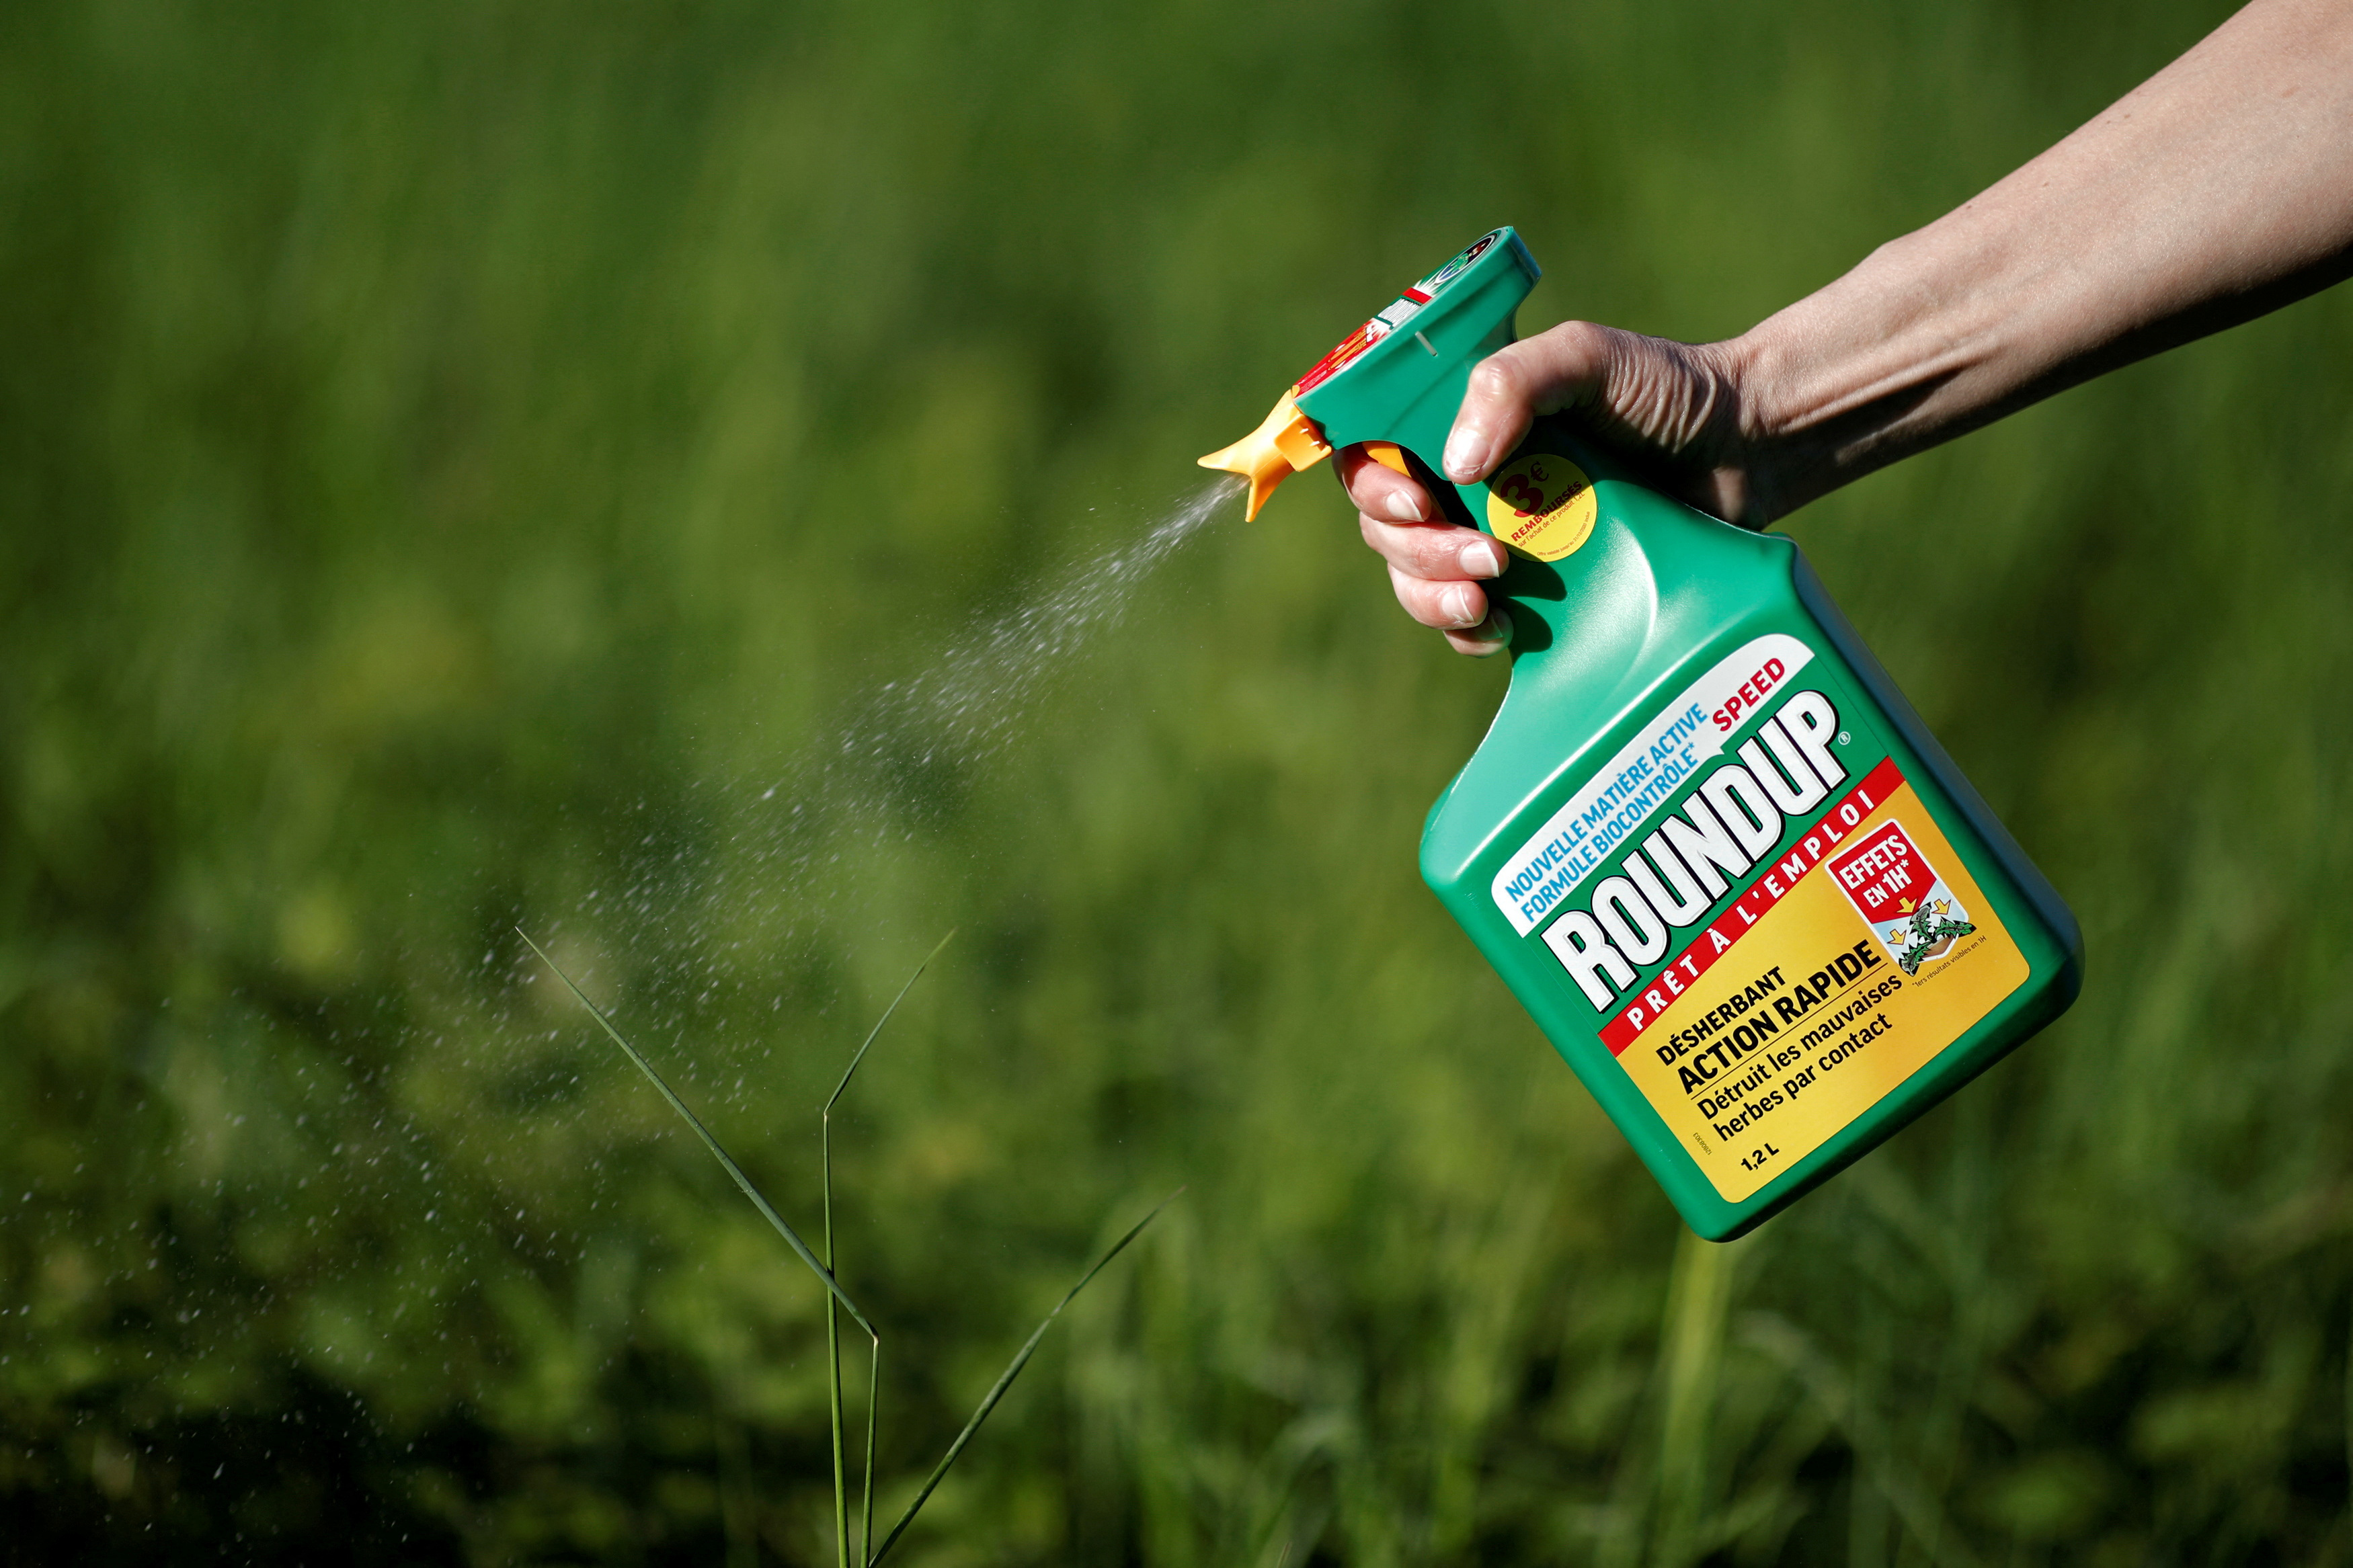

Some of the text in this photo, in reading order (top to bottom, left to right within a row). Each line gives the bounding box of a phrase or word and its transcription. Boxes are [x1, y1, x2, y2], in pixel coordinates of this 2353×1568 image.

[1511, 481, 1582, 542] REMBOURSÉS
[1518, 540, 1527, 548] sur
[1525, 526, 1544, 542] l'achat
[1542, 520, 1550, 528] de
[1556, 500, 1574, 518] produit
[1712, 658, 1786, 732] SPEED
[1504, 702, 1708, 903] NOUVELLE MATIÈRE ACTIVE
[1520, 845, 1598, 923] FORMULE
[1540, 690, 1850, 1014] ROUNDUP
[1839, 835, 1907, 890] EFFETS
[1627, 789, 1874, 1031] PRÊT À L'EMPLOI
[1863, 883, 1889, 908] EN
[1927, 961, 1951, 980] résultats
[1950, 947, 1971, 963] visibles
[1970, 941, 1979, 949] en
[1978, 935, 1987, 944] 1H
[1655, 966, 1786, 1066] DÉSHERBANT
[1677, 939, 1882, 1095] ACTION RAPIDE
[1696, 975, 1903, 1120] Détruit les mauvaises
[1712, 1012, 1892, 1142] herbes par contact
[1741, 1143, 1780, 1171] 1,2 L
